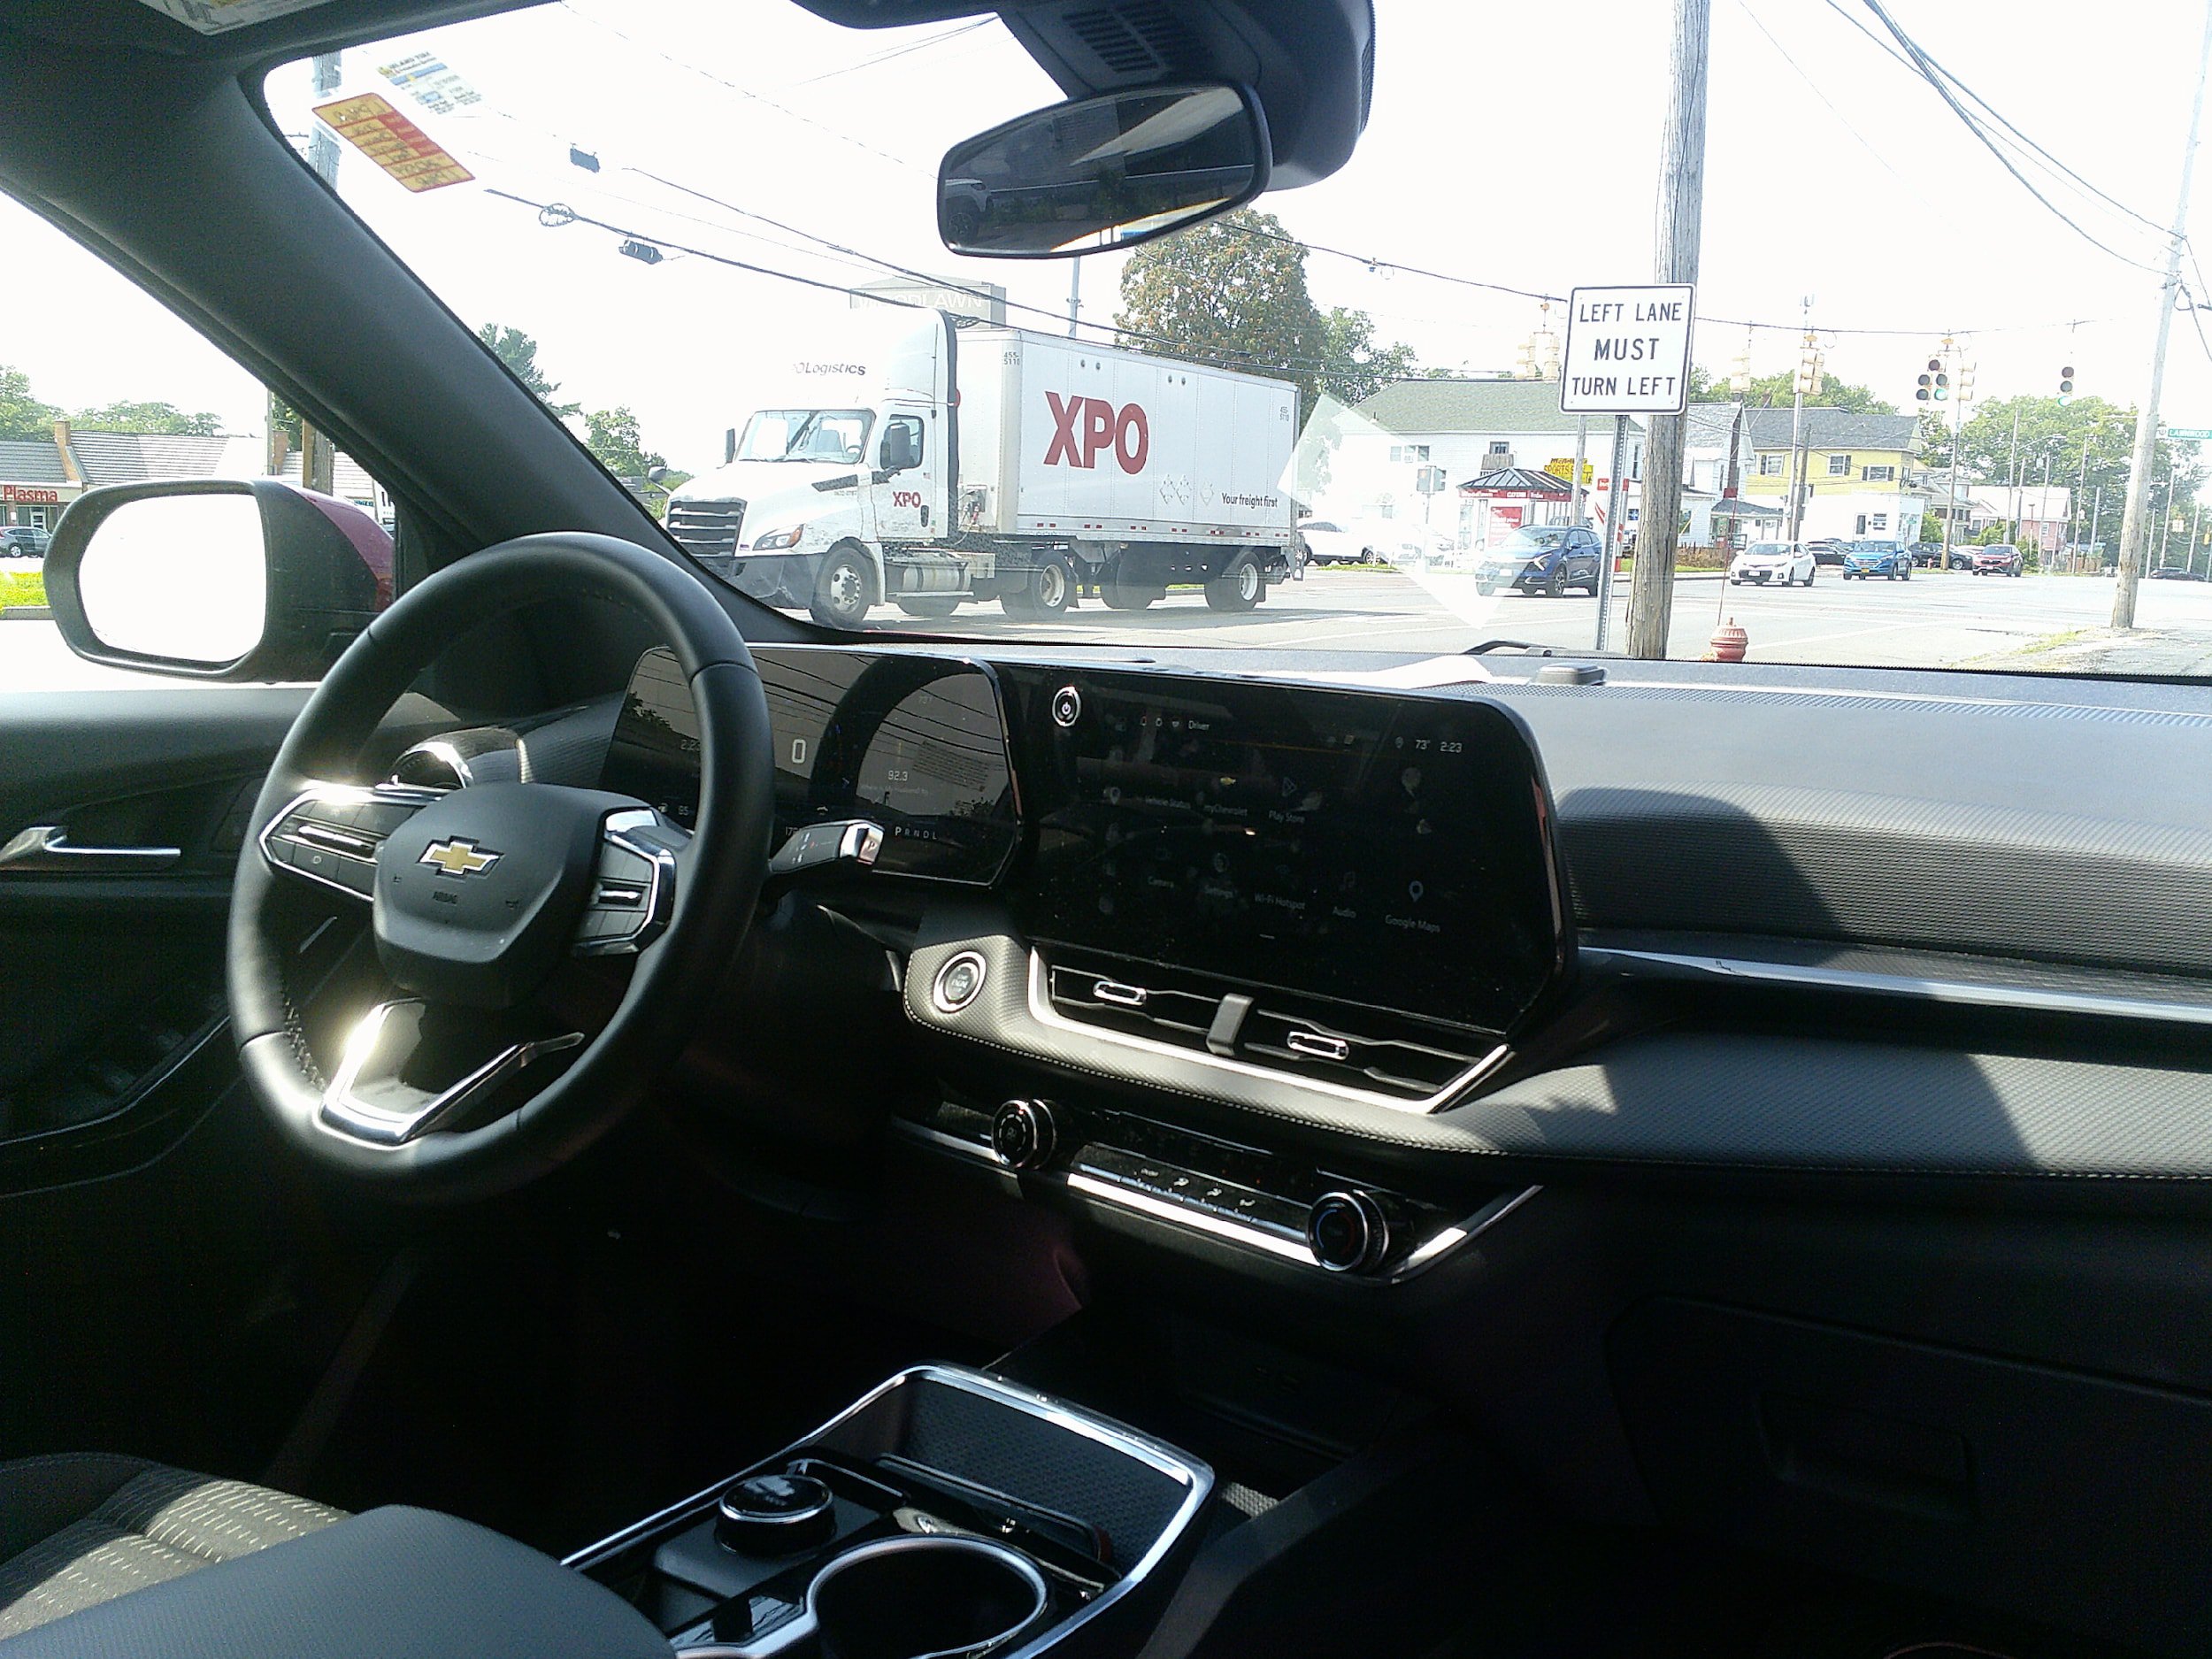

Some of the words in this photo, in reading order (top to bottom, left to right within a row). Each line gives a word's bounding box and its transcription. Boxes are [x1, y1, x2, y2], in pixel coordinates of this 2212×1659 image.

[1580, 303, 1624, 322] LEFT
[1636, 303, 1682, 321] LANE
[1594, 338, 1660, 361] MUST
[805, 362, 867, 376] Logistics
[1571, 377, 1617, 396] TURN
[1627, 377, 1676, 396] LEFT
[1043, 391, 1148, 474] XPO
[4, 485, 58, 502] Plasma
[893, 491, 921, 509] XPO
[1221, 492, 1238, 504] Your
[1239, 493, 1263, 509] freight
[1263, 496, 1278, 508] first
[792, 739, 806, 764] 0
[1440, 741, 1463, 754] 2:23
[887, 770, 909, 782] 92.3
[1385, 914, 1417, 929] Google
